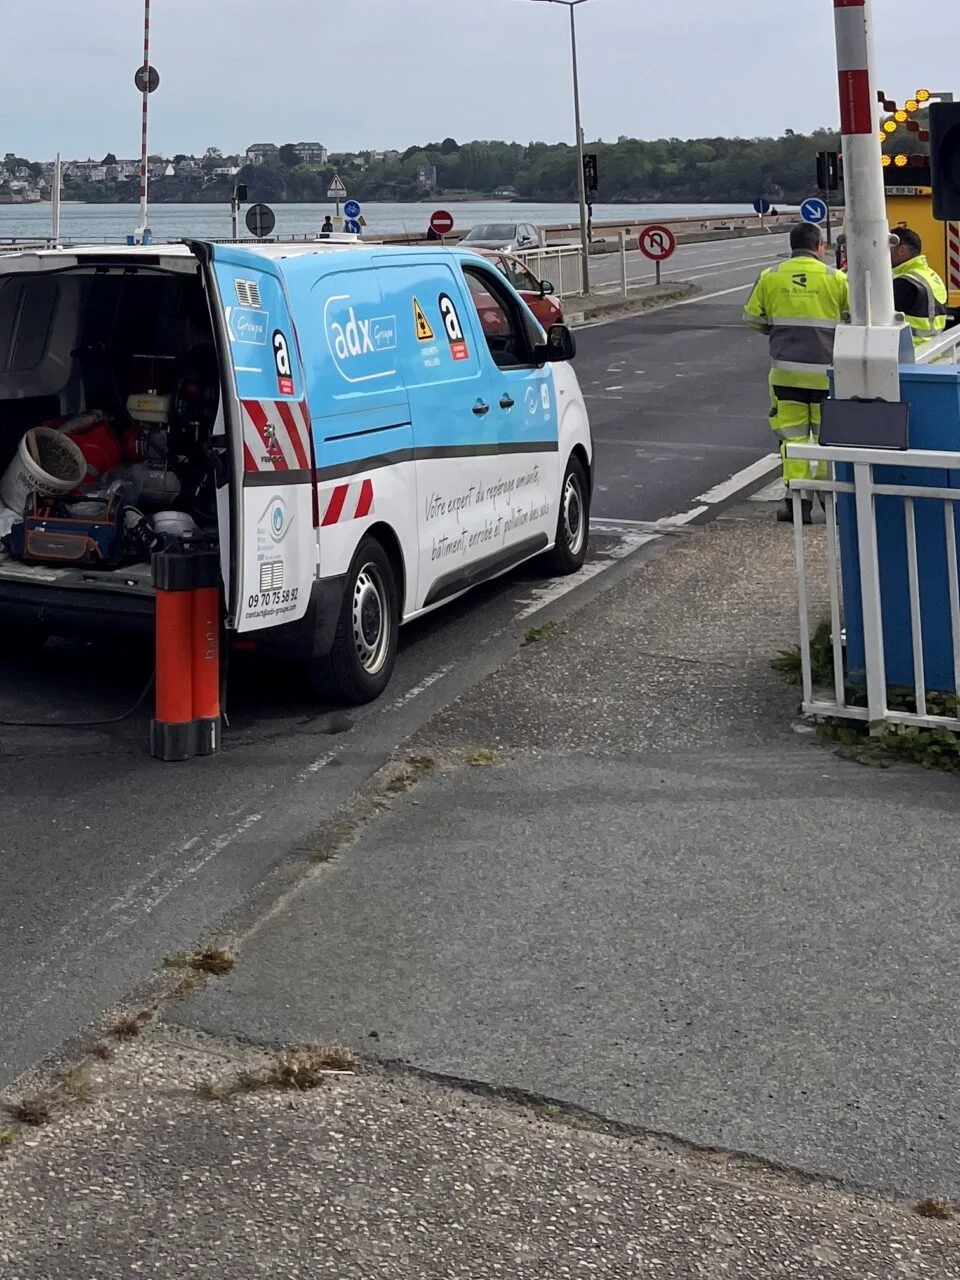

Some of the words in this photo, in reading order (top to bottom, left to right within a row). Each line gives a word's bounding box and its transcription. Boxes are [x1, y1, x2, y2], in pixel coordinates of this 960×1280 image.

[331, 307, 374, 359] adx
[425, 492, 445, 522] Votre
[448, 484, 475, 524] expert
[476, 480, 484, 504] du
[487, 478, 514, 511] repérage
[431, 528, 468, 561] bâtiment,
[469, 519, 493, 547] enrobé
[494, 516, 503, 538] et
[503, 508, 528, 546] pollution
[248, 594, 259, 608] 09
[260, 593, 270, 606] 70
[272, 591, 280, 605] 75
[281, 589, 290, 603] 58
[290, 587, 298, 601] 92
